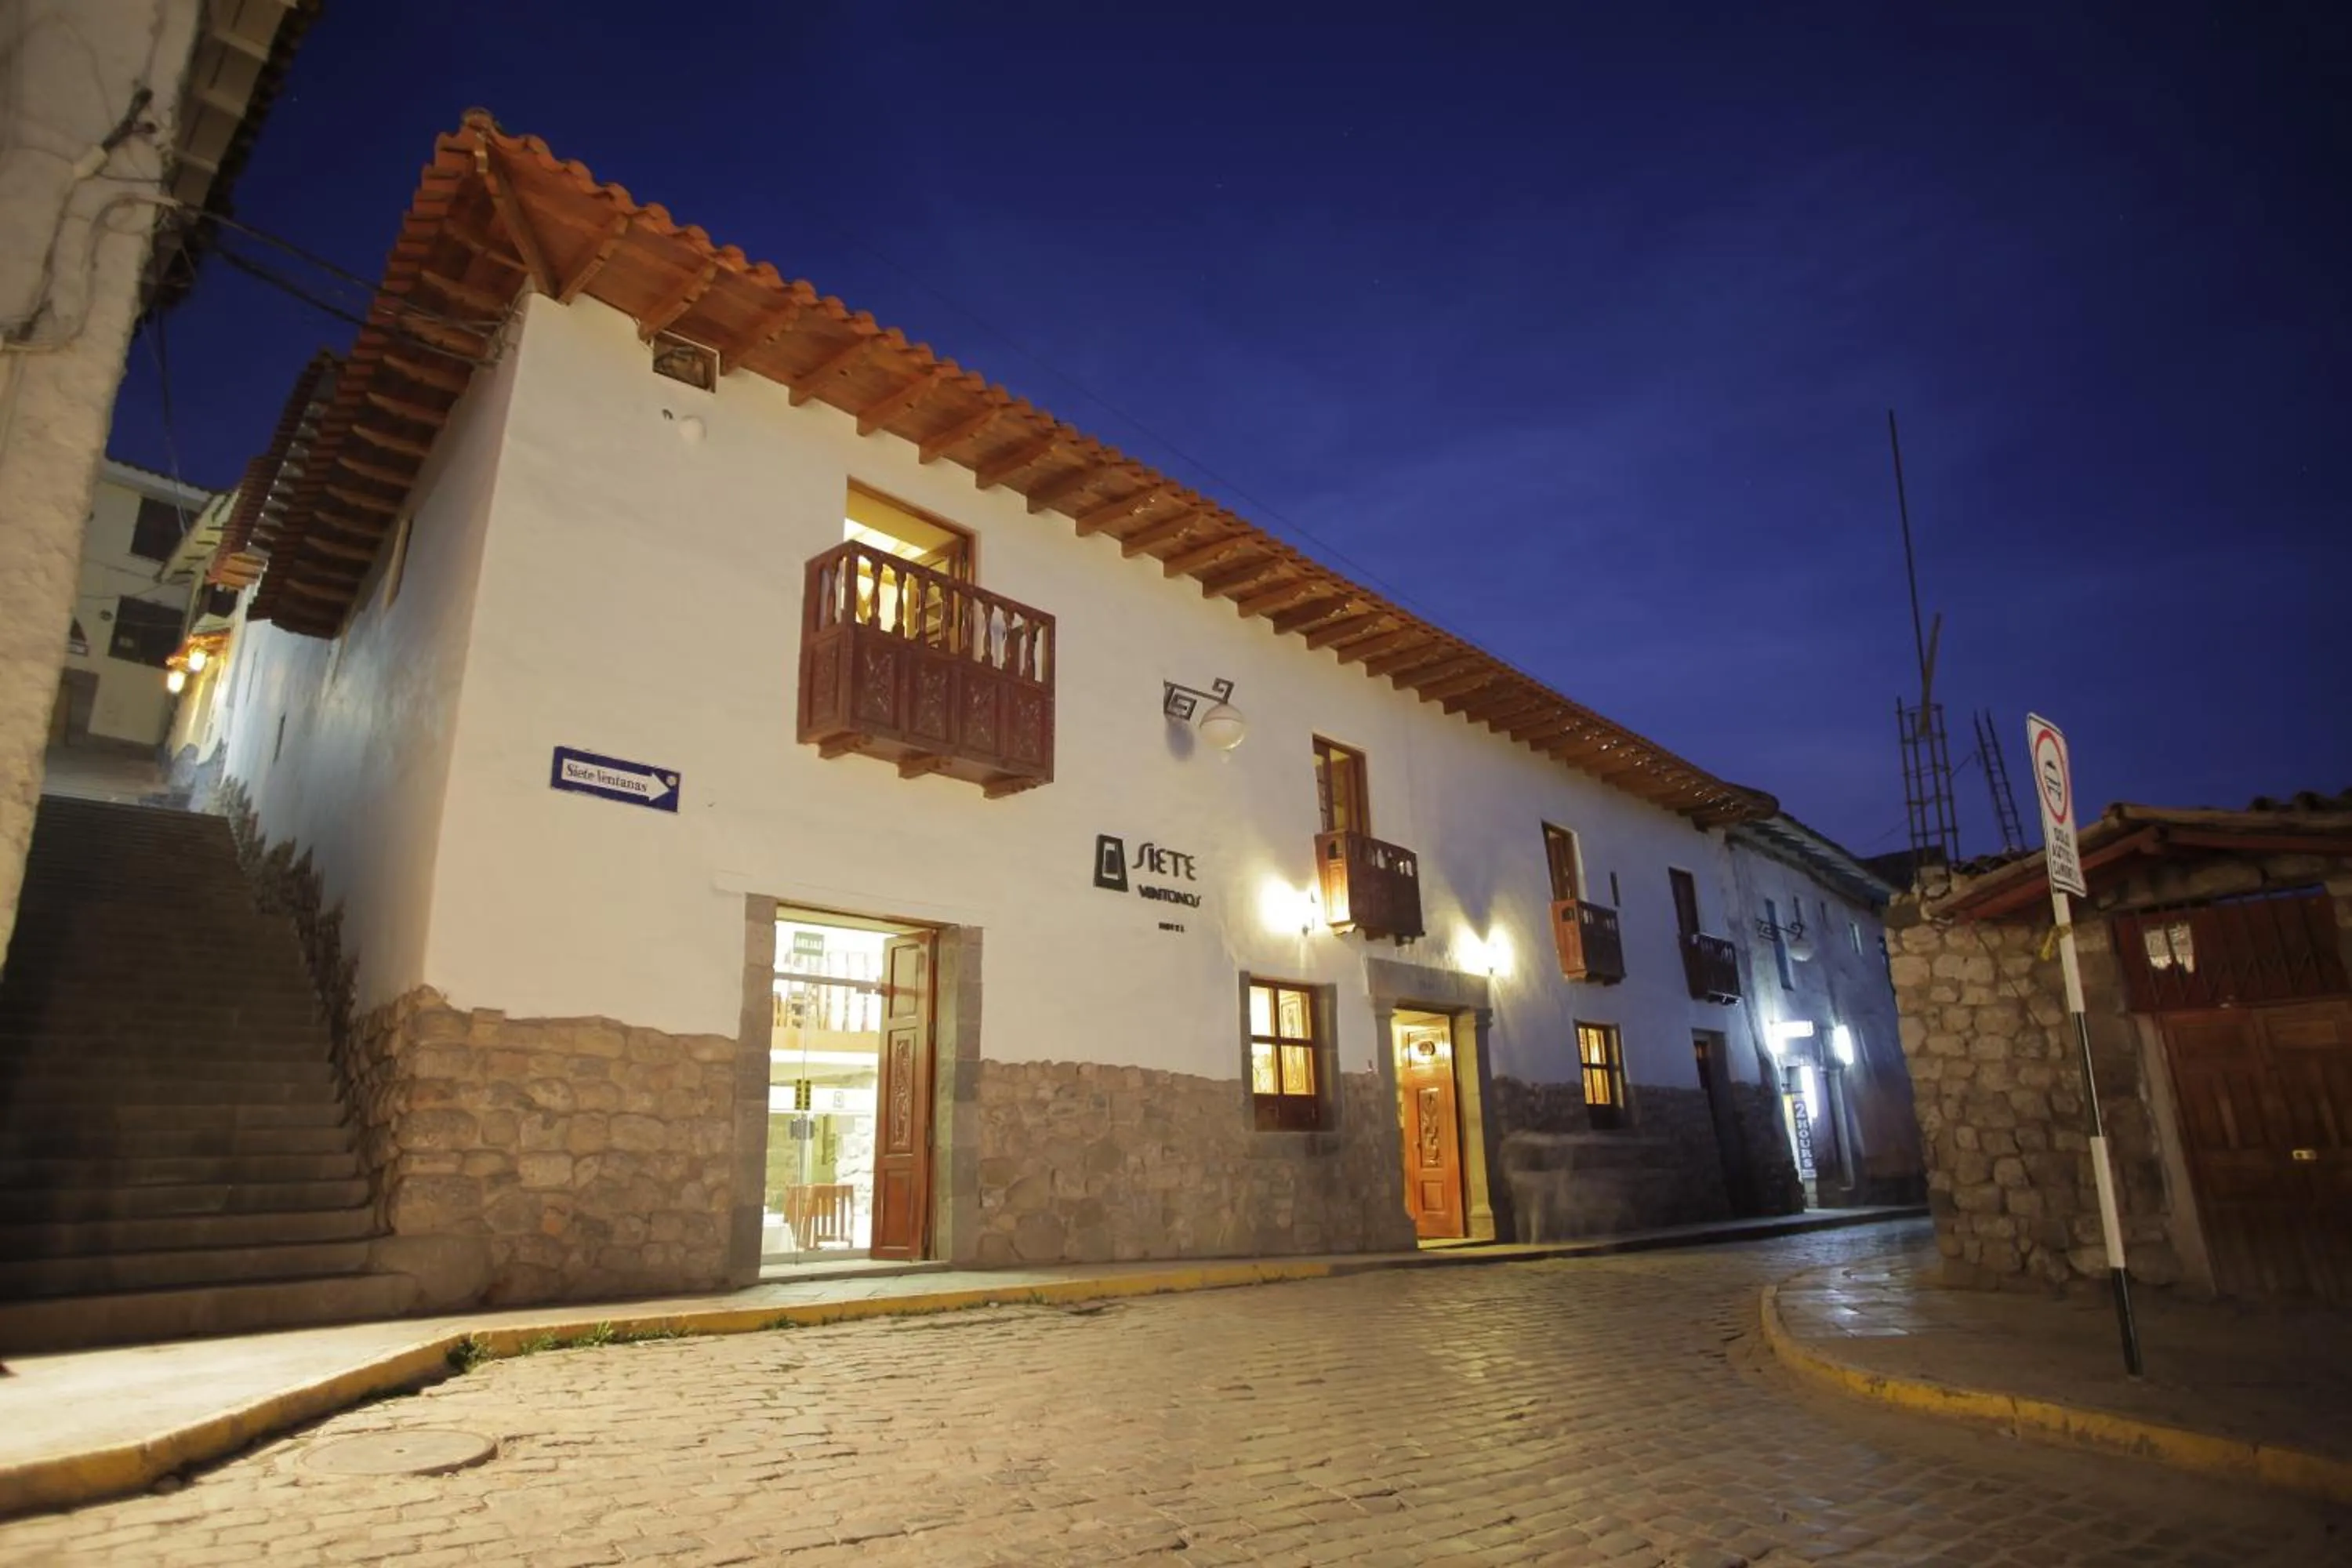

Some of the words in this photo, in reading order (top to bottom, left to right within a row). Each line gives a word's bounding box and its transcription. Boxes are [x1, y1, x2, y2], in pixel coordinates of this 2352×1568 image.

[566, 763, 595, 780] Siete
[597, 769, 648, 793] Ventanas
[1131, 842, 1196, 881] SIETE
